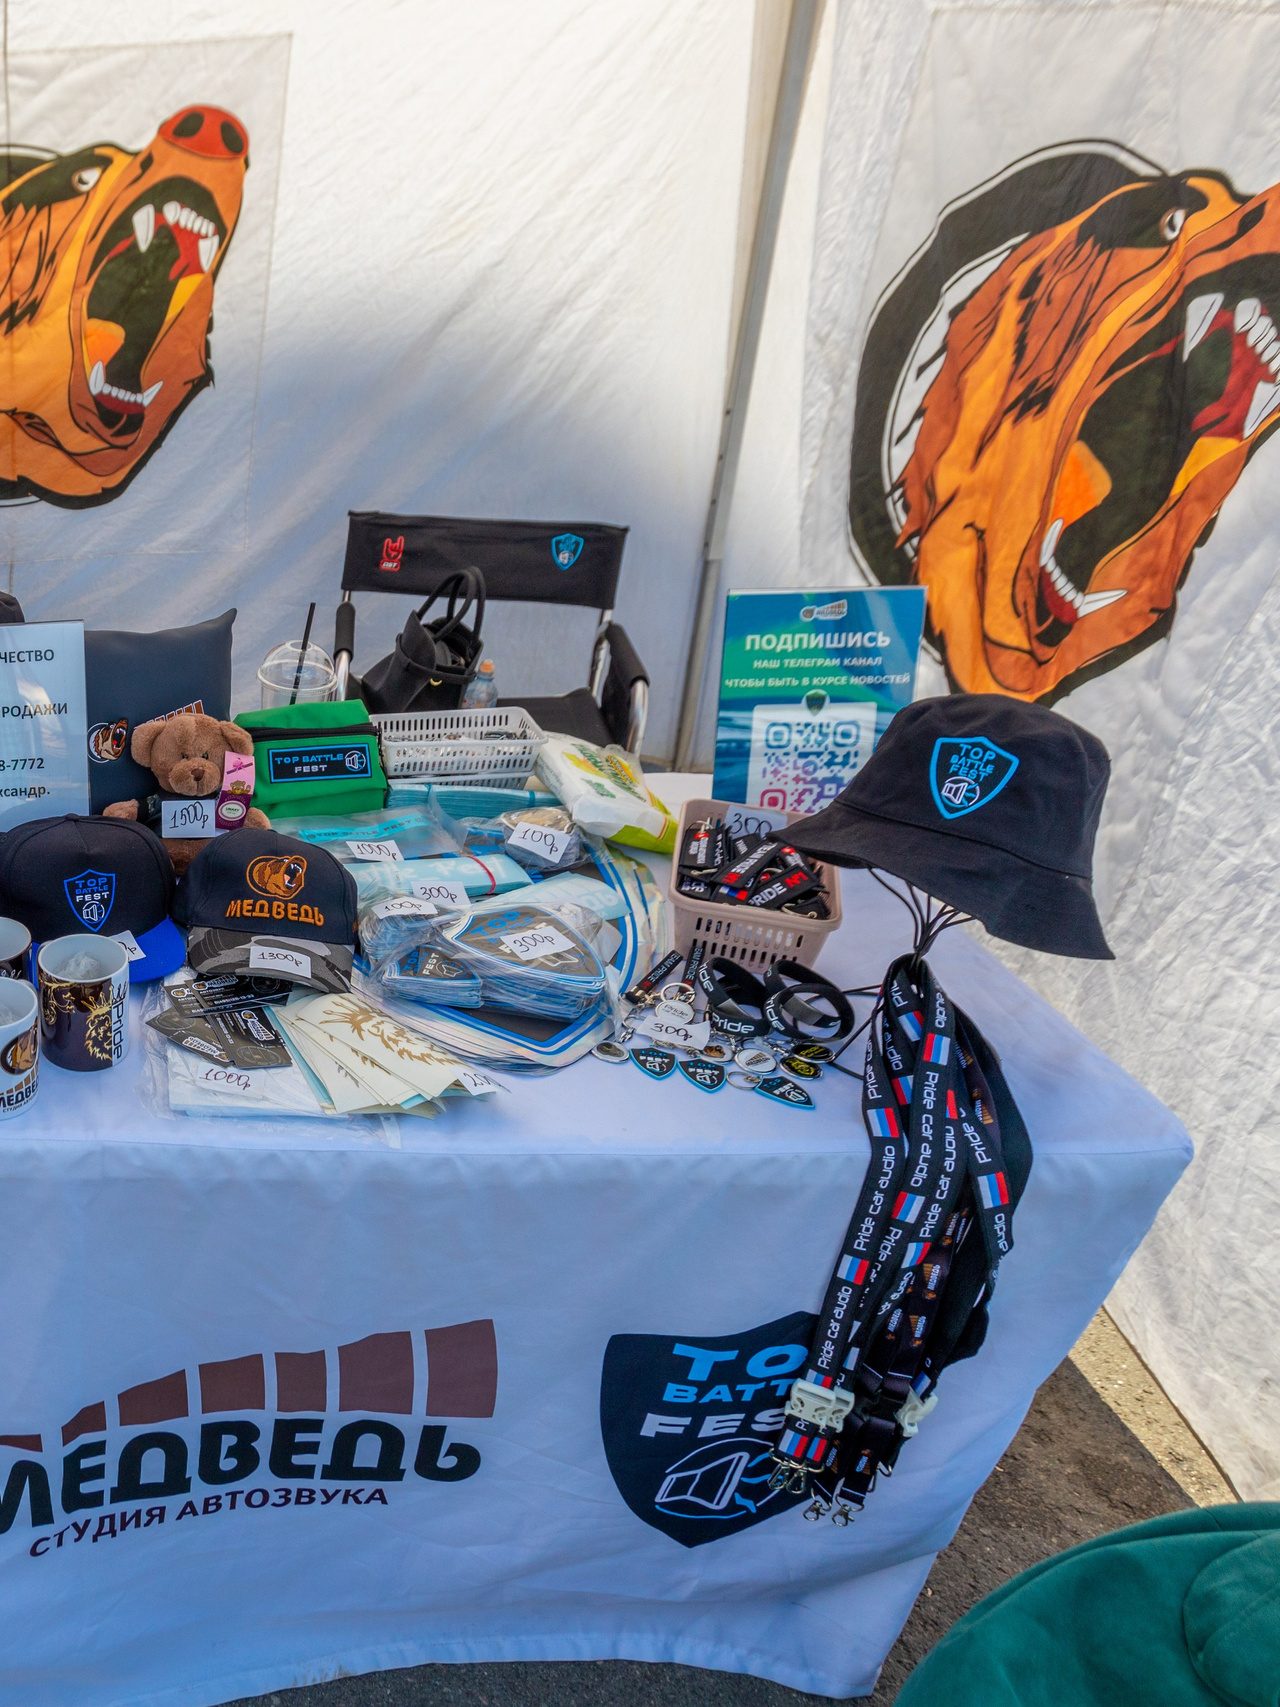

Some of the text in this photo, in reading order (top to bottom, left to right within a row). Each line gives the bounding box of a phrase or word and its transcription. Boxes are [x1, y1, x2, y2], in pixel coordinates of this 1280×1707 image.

[745, 631, 891, 652] ПОДПИШИСЬ
[753, 656, 883, 669] НАШ ТЕЛЕГРАМ КАНАЛ
[725, 672, 911, 688] ЧТОБЫ БЫТЬ В КУРСЕ НОВОСТЕЙ
[274, 753, 344, 765] TOP BATTLE
[950, 754, 996, 774] BATTLE
[959, 743, 996, 762] TOP
[294, 764, 327, 774] FEST
[949, 764, 990, 782] FEST
[518, 828, 560, 855] 100р
[75, 877, 108, 888] TOP
[75, 885, 109, 895] BATTLE
[76, 892, 110, 903] FEST
[225, 899, 325, 927] МЕДВЕДЬ
[470, 911, 522, 936] TOP
[422, 952, 440, 976] FEST
[935, 992, 948, 1028] audio
[113, 1000, 125, 1060] Pride
[884, 1031, 904, 1071] audio
[910, 1071, 939, 1188] Pride car audio
[962, 1122, 993, 1164] Pride
[853, 1145, 895, 1251] Pride car audio
[919, 1203, 942, 1238] Pride
[935, 1175, 952, 1200] car
[878, 1226, 903, 1262] Pride
[994, 1212, 1010, 1253] audio
[817, 1285, 853, 1370] Pride car audio
[672, 1343, 809, 1382] TO
[662, 1378, 797, 1404] BATT
[639, 1407, 786, 1438] FES
[29, 1486, 390, 1558] СТУДИЯ АВТОЗВУКА
